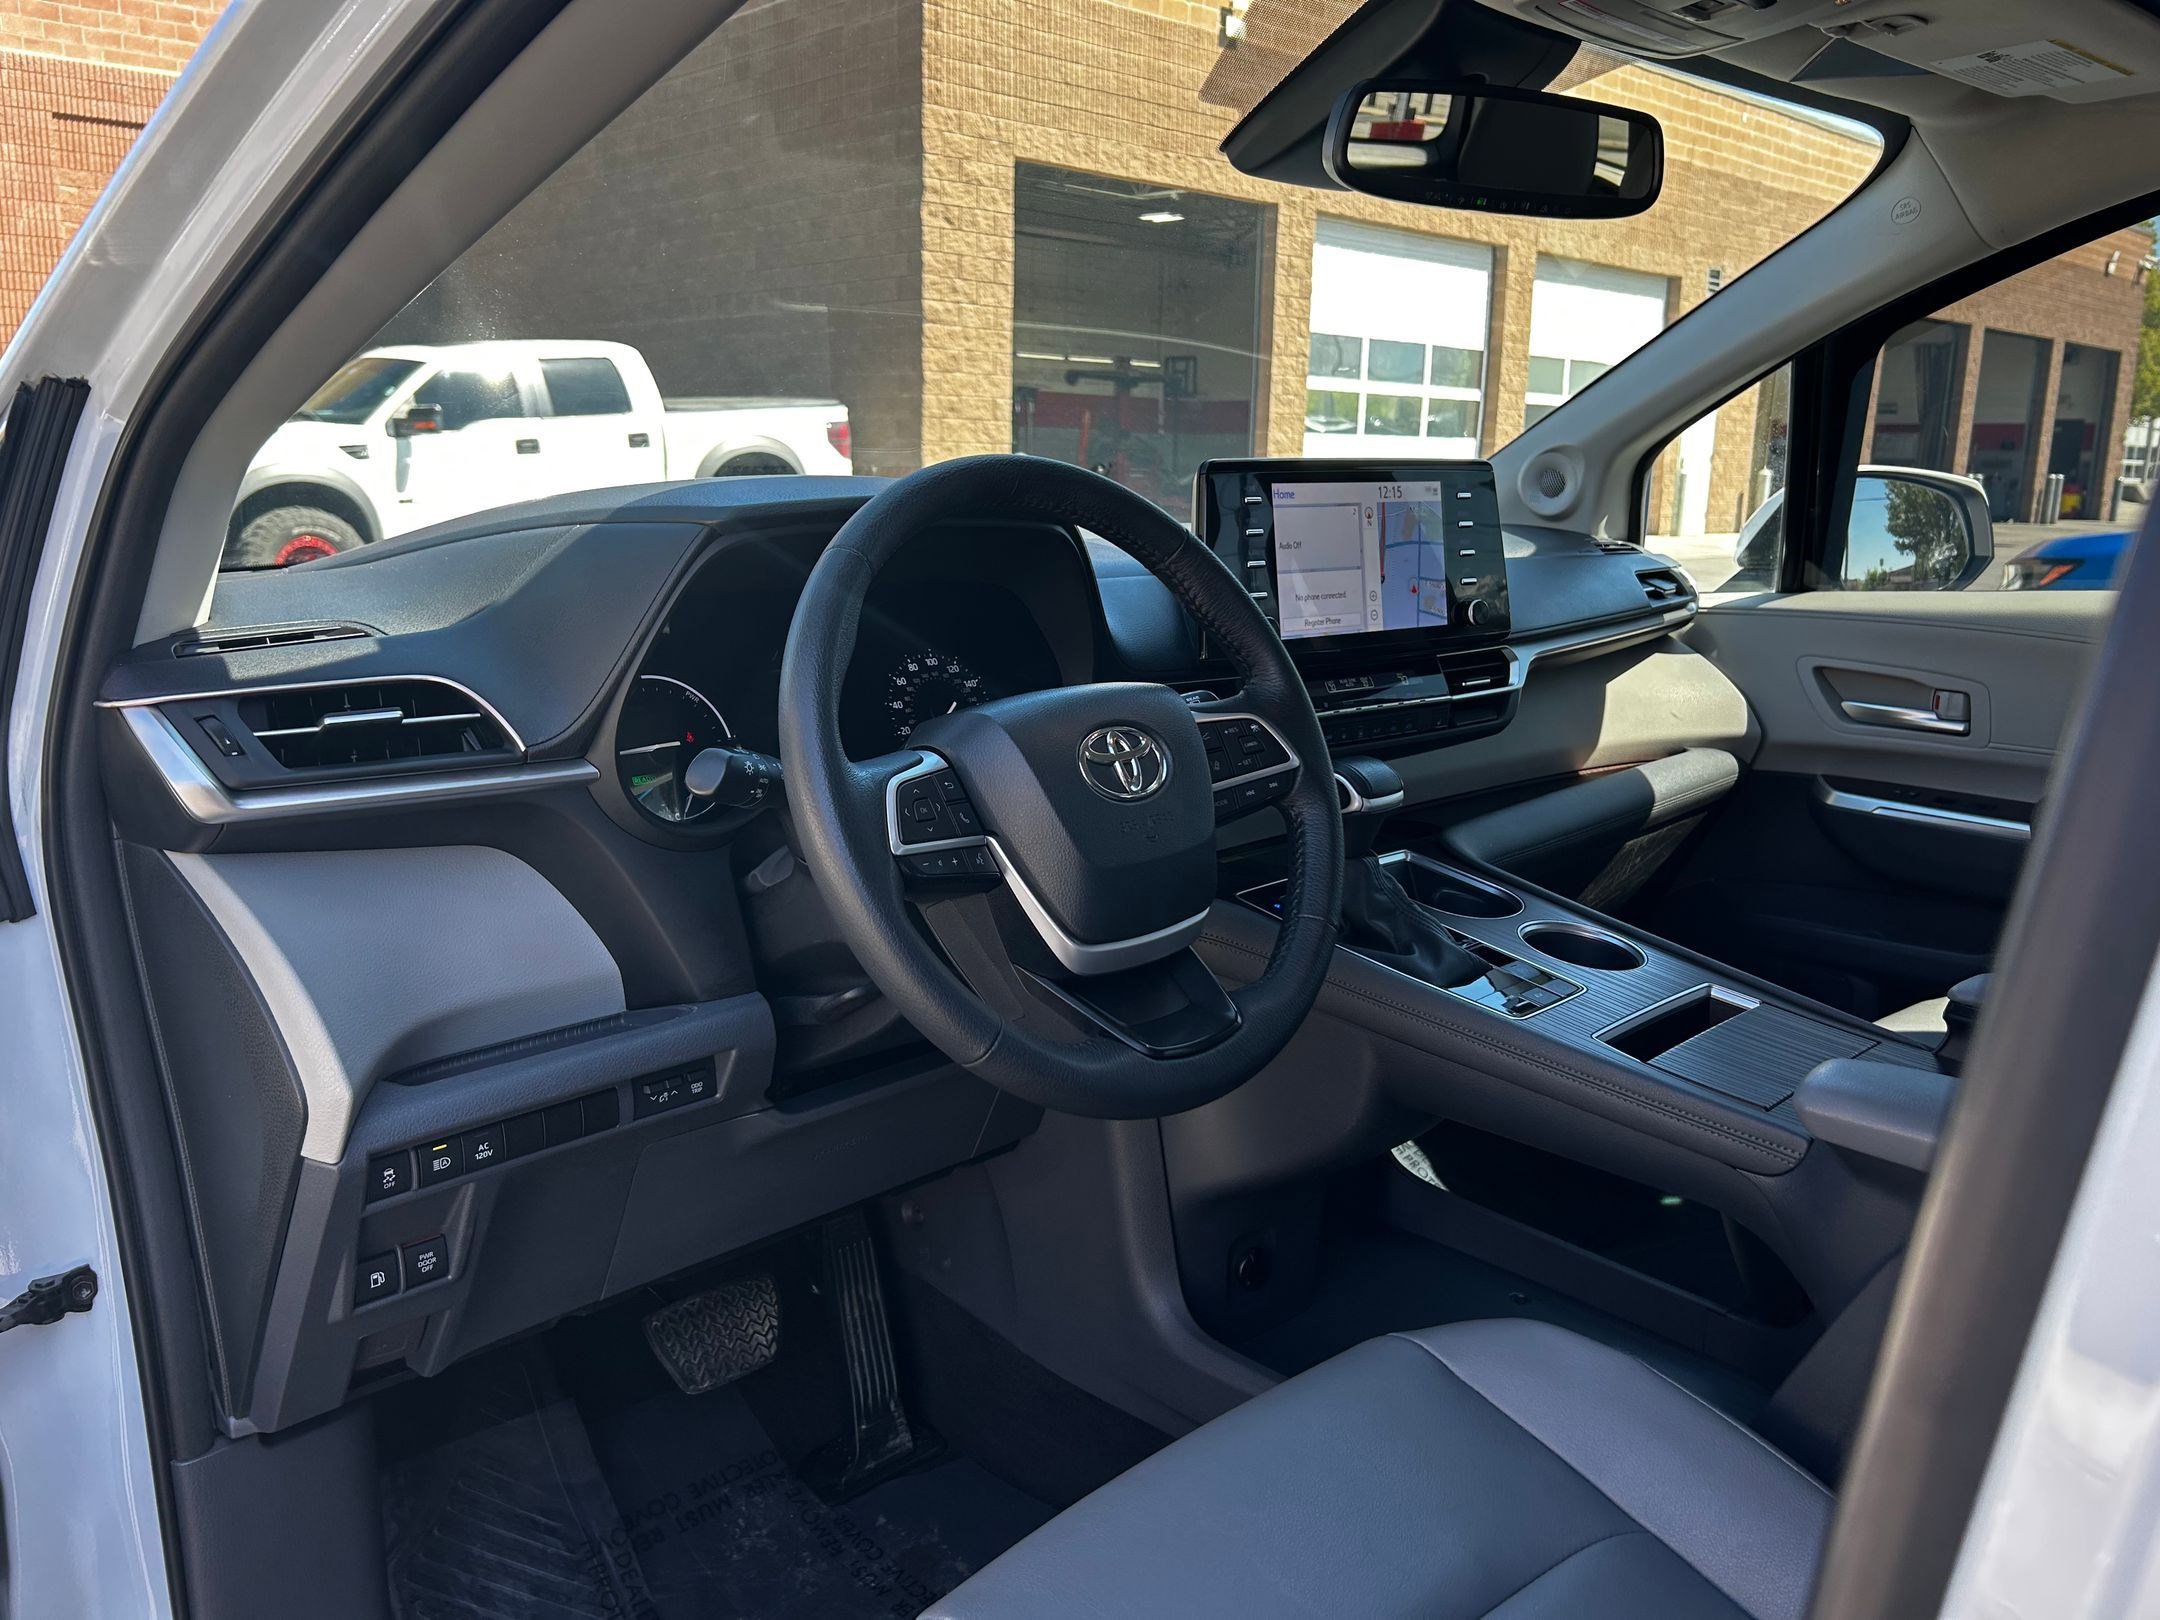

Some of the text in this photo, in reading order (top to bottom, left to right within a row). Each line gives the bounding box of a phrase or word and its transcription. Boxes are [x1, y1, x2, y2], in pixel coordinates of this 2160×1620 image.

[1273, 488, 1295, 499] Home
[1378, 486, 1402, 499] 12:15
[1279, 541, 1292, 550] Audio
[1295, 591, 1347, 603] No phone connected
[1304, 617, 1341, 628] Register Phone
[925, 657, 938, 666] 100
[908, 663, 919, 672] 80
[947, 665, 960, 673] 120
[896, 677, 906, 686] 60
[964, 679, 977, 687] 140
[685, 690, 700, 703] PWR
[892, 700, 903, 709] 40
[900, 726, 911, 735] 20
[478, 1142, 490, 1151] AC
[474, 1149, 493, 1160] 120V
[383, 1181, 396, 1189] OFF
[419, 1251, 434, 1260] PWR
[417, 1257, 437, 1268] DOOR
[421, 1264, 433, 1272] OFF
[675, 1493, 732, 1534] MUST
